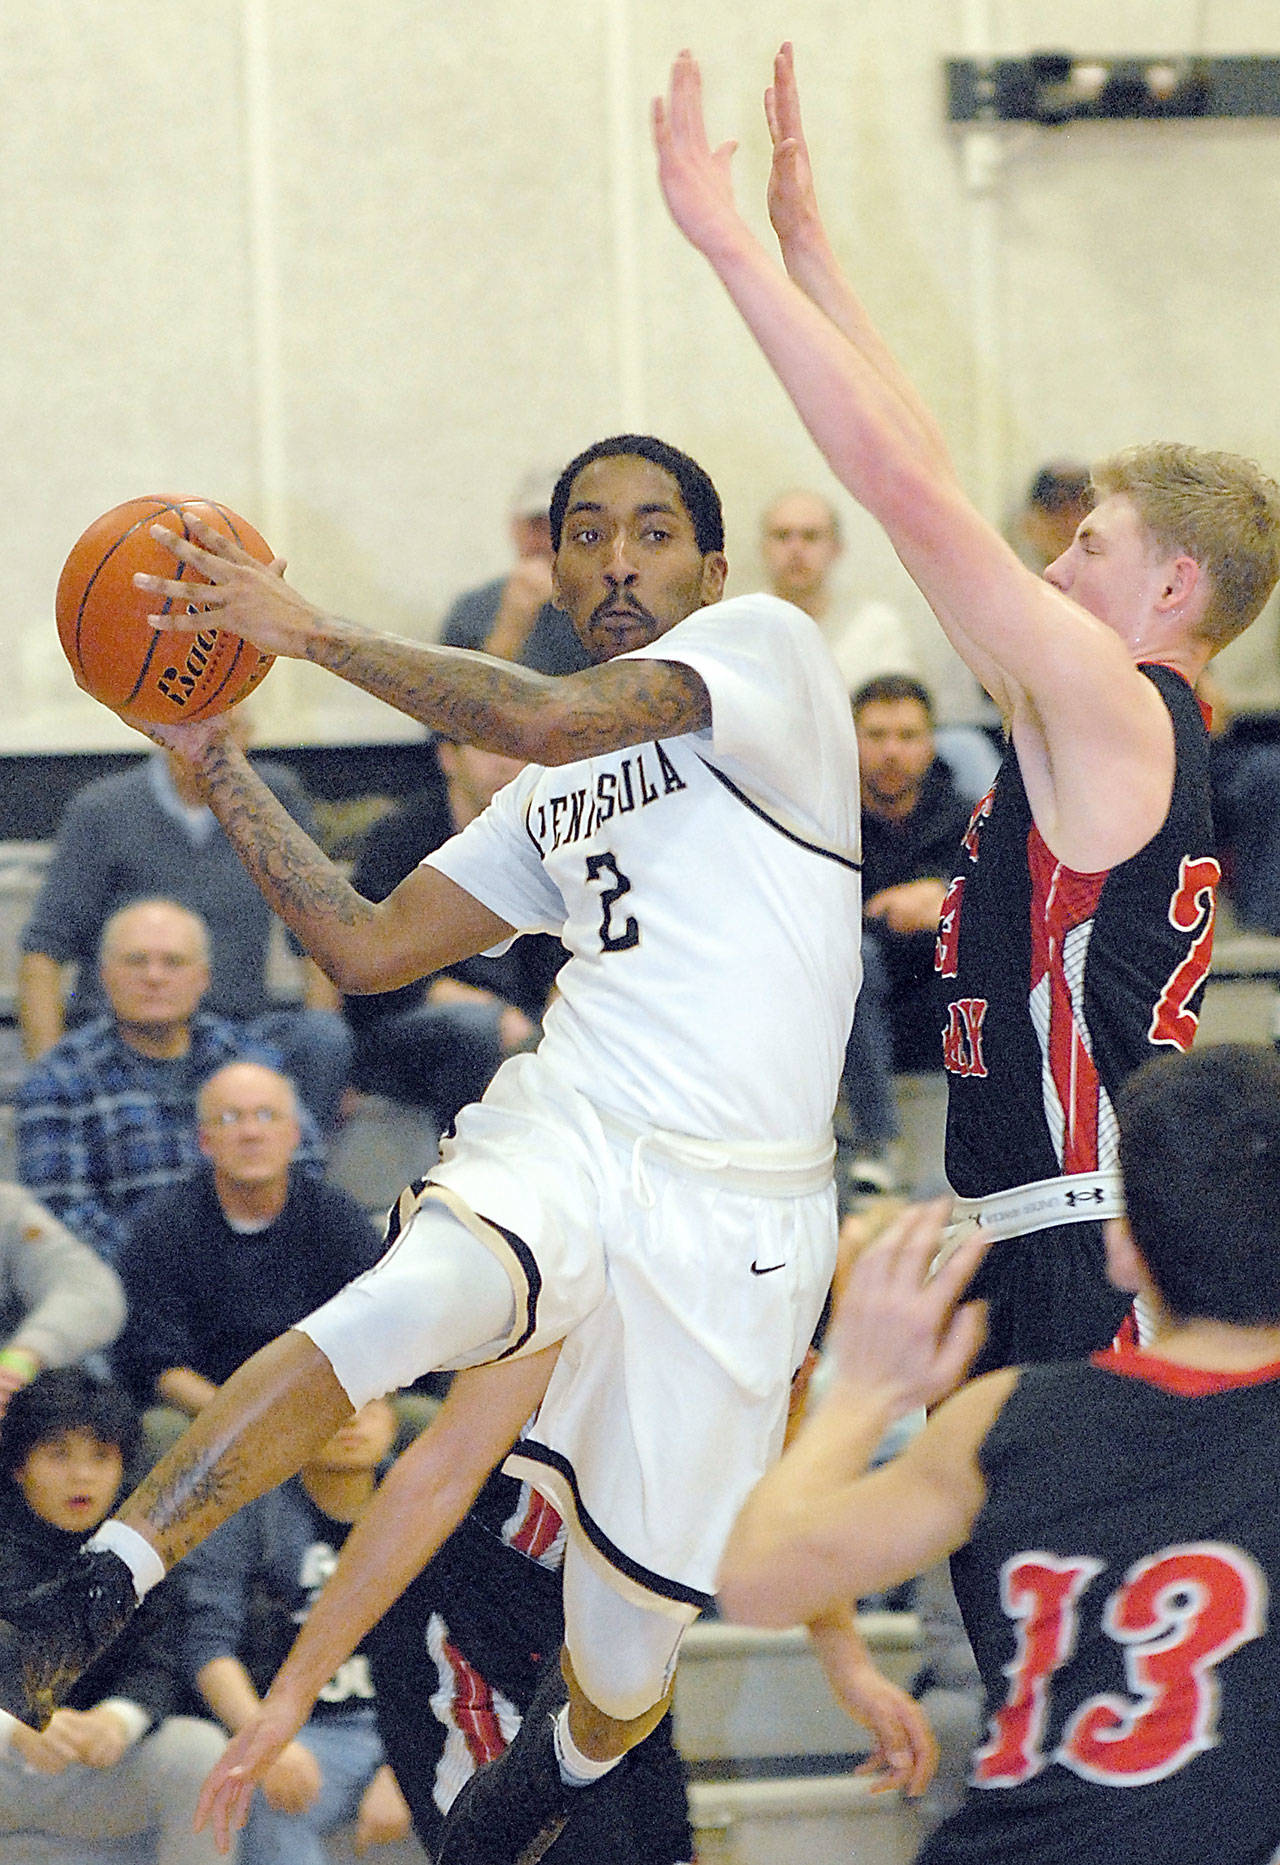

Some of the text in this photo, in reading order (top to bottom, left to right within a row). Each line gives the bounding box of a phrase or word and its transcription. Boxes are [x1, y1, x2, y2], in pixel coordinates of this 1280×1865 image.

[585, 851, 640, 953] 2
[1148, 854, 1221, 1053] 2
[969, 1541, 1267, 1789] 13
